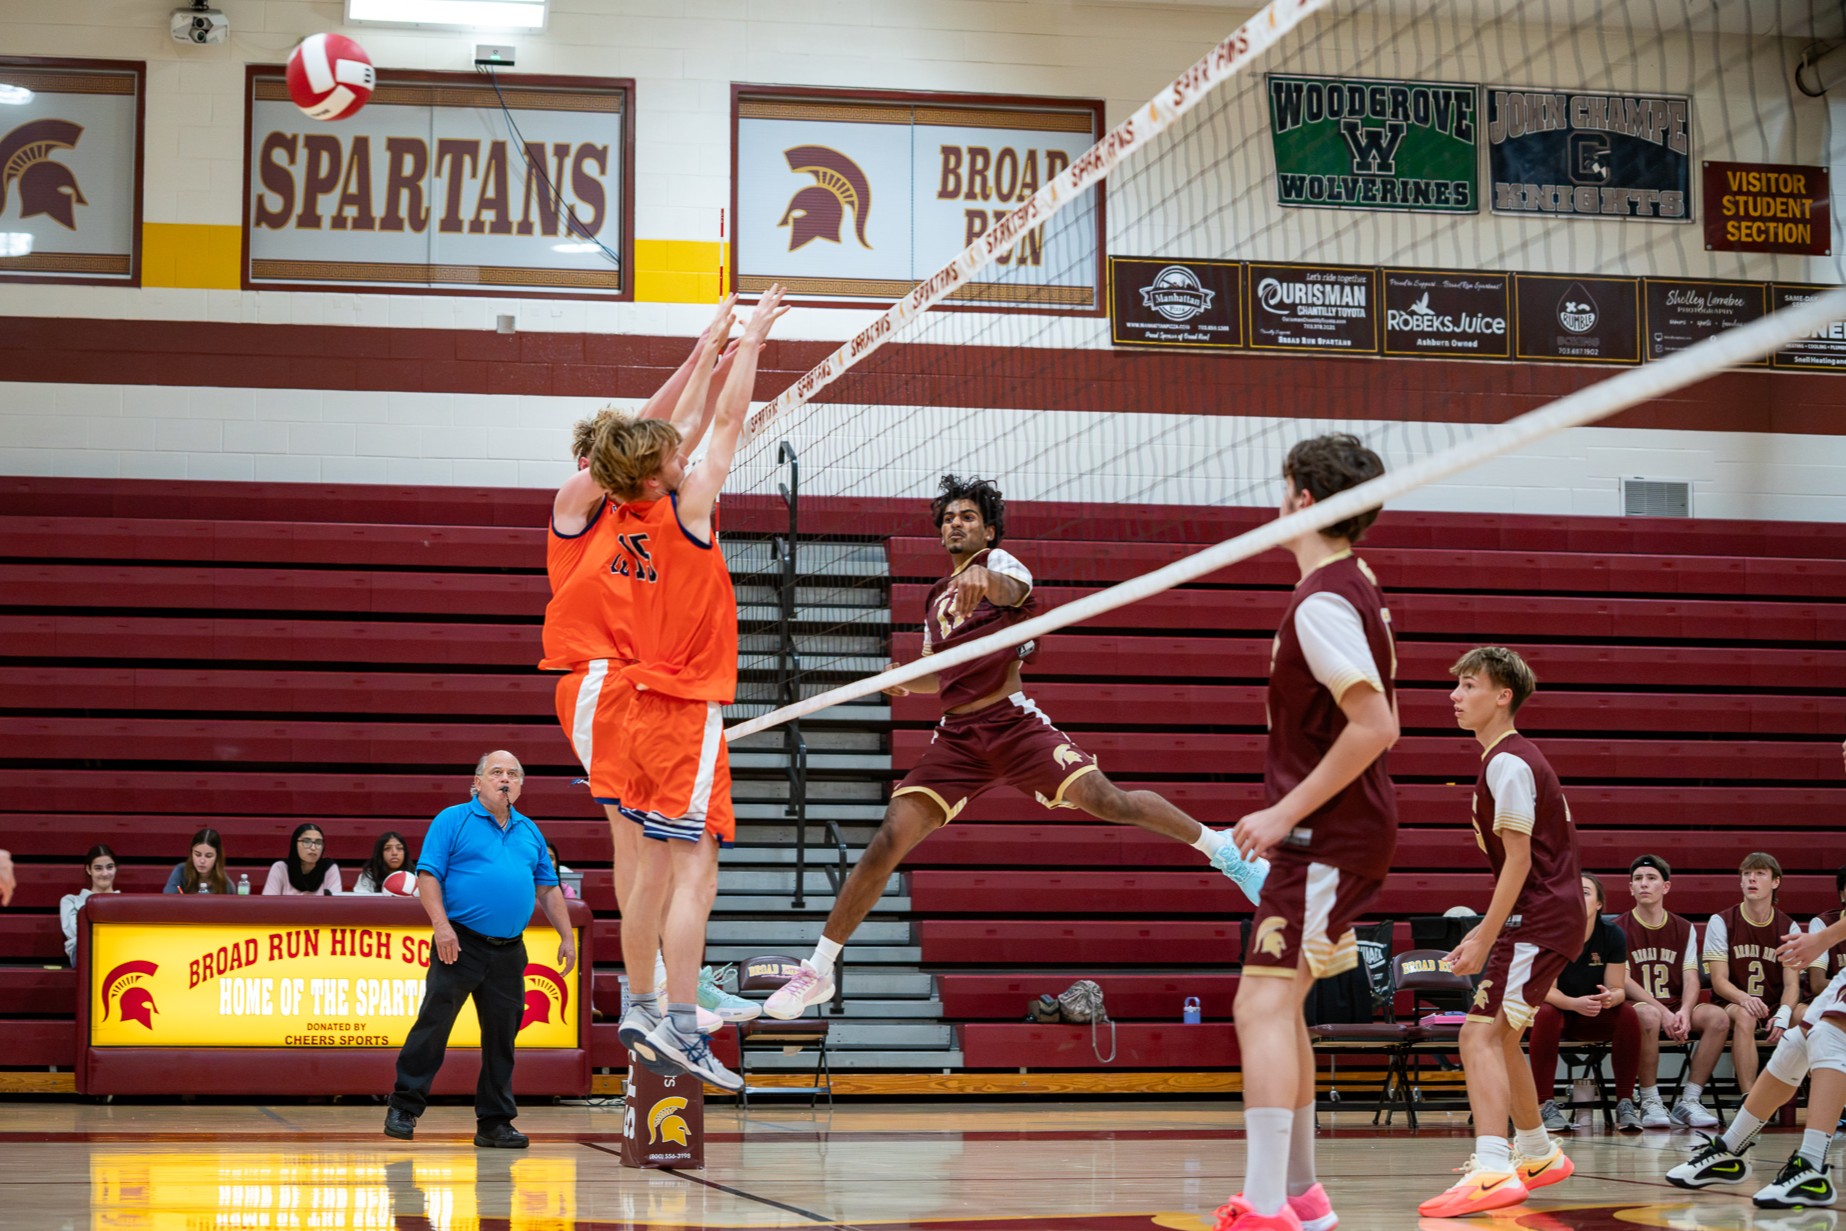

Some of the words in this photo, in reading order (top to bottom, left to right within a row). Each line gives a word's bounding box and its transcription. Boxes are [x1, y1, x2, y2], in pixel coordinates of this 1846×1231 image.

[1271, 80, 1475, 145] WOODGROVE
[1489, 91, 1567, 145] JOHN
[1570, 95, 1688, 156] CHAMPE
[1340, 118, 1407, 175] W
[254, 131, 609, 238] SPARTANS
[937, 145, 1072, 203] BROAD
[1726, 170, 1806, 195] VISITOR
[1279, 172, 1471, 208] WOLVERINES
[1495, 182, 1685, 216] KNIGHTS
[1722, 195, 1814, 219] STUDENT
[1726, 222, 1812, 245] SECTION
[1155, 292, 1201, 306] Manhattan
[1257, 278, 1367, 314] OURISMAN
[1666, 290, 1705, 309] Shelley
[1297, 305, 1337, 317] CHANTILLY
[1338, 307, 1366, 318] TOYOTA
[1454, 312, 1506, 334] Juice
[1562, 313, 1594, 330] RUMBLE
[1677, 306, 1735, 315] PHOTOGRAPHY
[1416, 338, 1450, 347] Ashburn
[1451, 338, 1478, 348] Owned
[189, 938, 258, 989] BROAD
[268, 929, 320, 962] RUN
[330, 928, 392, 960] HIGH
[1401, 959, 1436, 974] BROAD
[1641, 963, 1671, 999] 12
[1748, 960, 1765, 997] 2
[219, 977, 274, 1016] HOME
[280, 977, 304, 1016] OF
[310, 978, 349, 1016] THE
[307, 1023, 351, 1031] DONATED
[351, 1023, 366, 1031] BY
[285, 1035, 335, 1046] CHEERS
[339, 1035, 389, 1046] SPORTS
